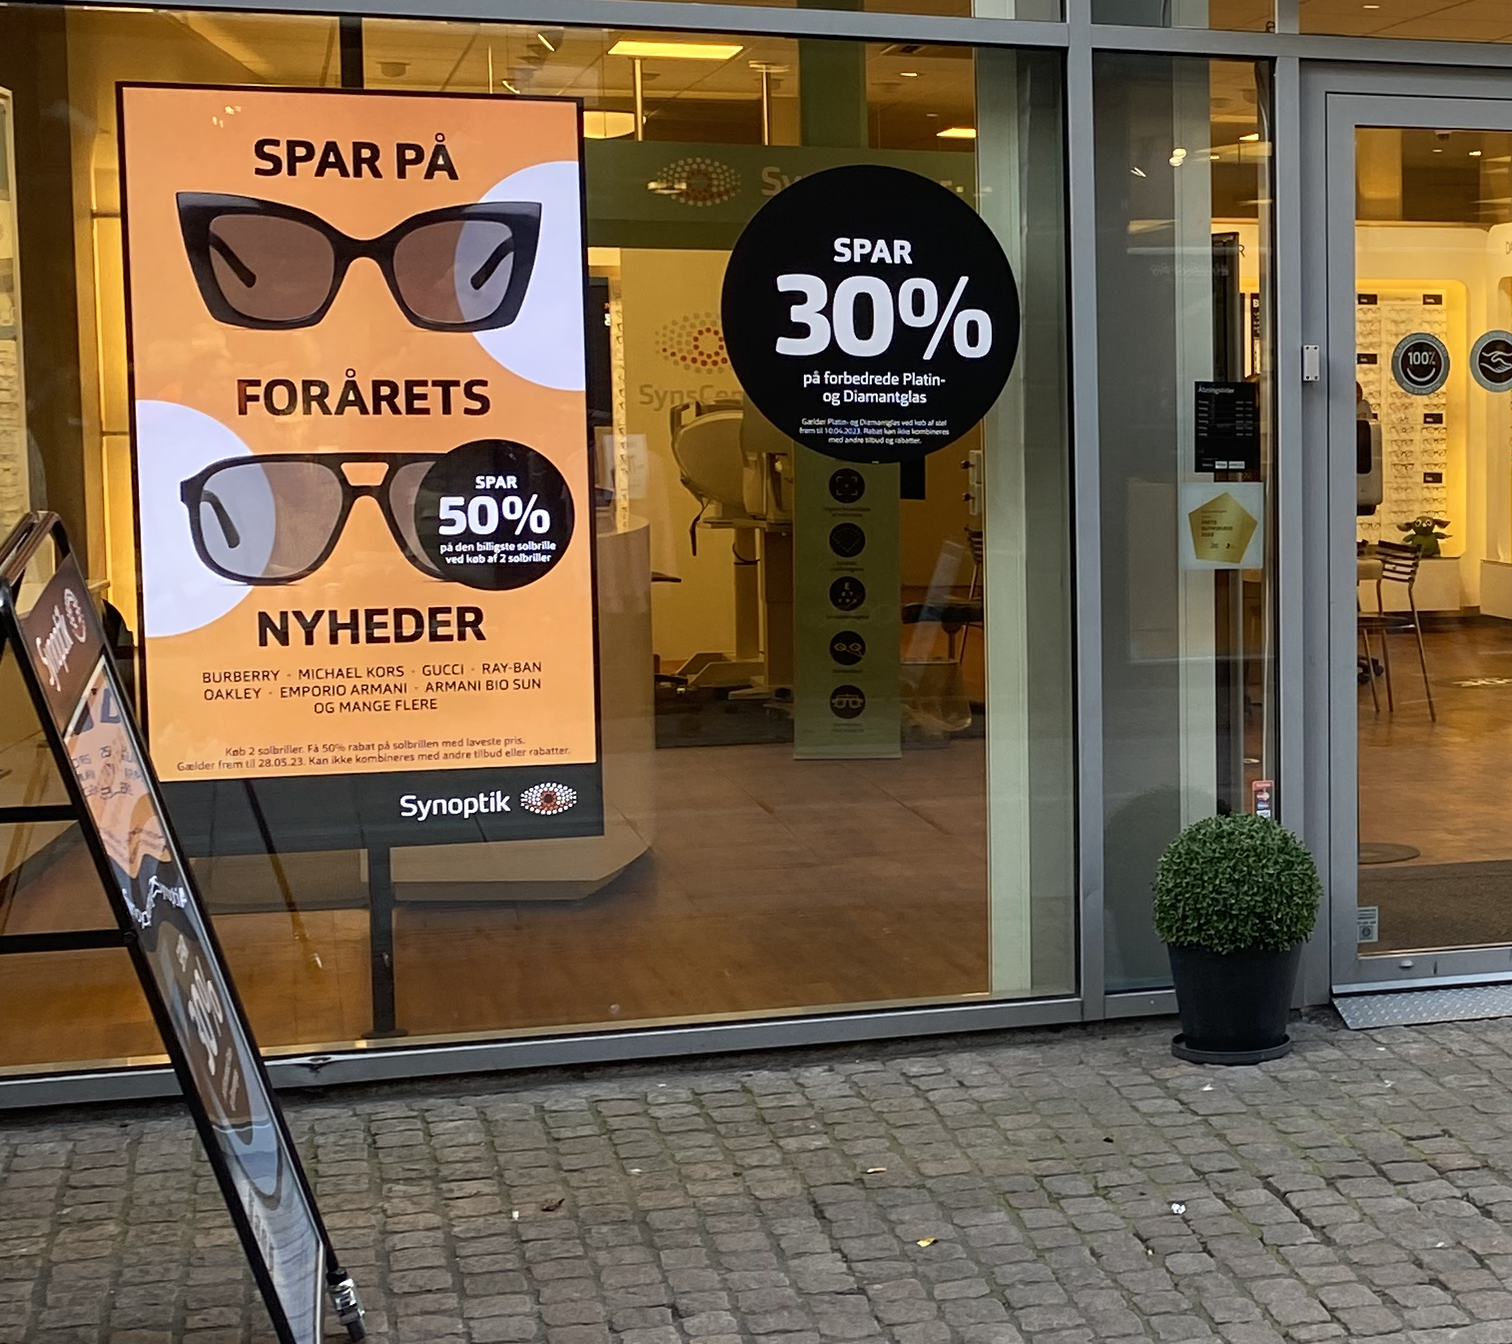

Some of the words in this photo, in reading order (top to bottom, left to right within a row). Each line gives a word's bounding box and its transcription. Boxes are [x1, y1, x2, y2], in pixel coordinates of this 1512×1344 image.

[254, 138, 383, 179] SPAR
[395, 132, 459, 180] PÅ
[833, 237, 913, 264] SPAR
[775, 273, 993, 361] 30%
[1407, 351, 1436, 365] 100%
[803, 370, 820, 387] på
[824, 371, 900, 386] forbedrede
[902, 372, 946, 386] Platin-
[236, 368, 491, 416] FORÅRETS
[822, 392, 841, 406] og
[843, 390, 927, 406] Diamantglas
[475, 475, 518, 489] SPAR
[438, 494, 551, 536] 50%
[440, 541, 454, 554] på
[455, 542, 475, 552] den
[476, 541, 515, 554] billigste
[517, 541, 557, 551] solbrille
[445, 554, 466, 564] ved
[466, 554, 486, 564] køb
[487, 554, 497, 564] af
[499, 554, 507, 563] 2
[508, 553, 552, 564] solbriller
[258, 606, 487, 647] NYHEDER
[202, 670, 280, 683] BURBERRY
[298, 667, 363, 680] MICHAEL
[366, 666, 405, 678] KORS
[422, 664, 465, 676] GUCCI
[481, 661, 542, 675] RAY-BAN
[204, 688, 262, 701] OAKLEY
[280, 685, 347, 698] EMPORIO
[350, 682, 408, 695] ARMANI
[424, 680, 482, 693] ARMANI
[486, 679, 509, 691] BIO
[513, 678, 542, 690] SUN
[313, 702, 336, 714] OG
[339, 700, 392, 713] MANGE
[395, 698, 438, 711] FLERE
[225, 747, 246, 756] Køb
[248, 747, 255, 755] 2
[307, 743, 319, 753] Få
[322, 743, 346, 753] 50%
[348, 742, 375, 752] rabat
[377, 740, 391, 754] på
[393, 739, 439, 750] solbrillen
[441, 738, 464, 748] med
[466, 737, 502, 747] laveste
[177, 761, 215, 772] Gælder
[218, 759, 243, 769] frem
[245, 758, 256, 769] til
[308, 756, 328, 766] Kan
[331, 755, 353, 765] ikke
[355, 752, 415, 764] kombineres
[417, 751, 440, 761] med
[442, 750, 472, 760] andre
[474, 748, 502, 759] tilbud
[505, 747, 527, 757] eller
[400, 790, 512, 821] Synoptik
